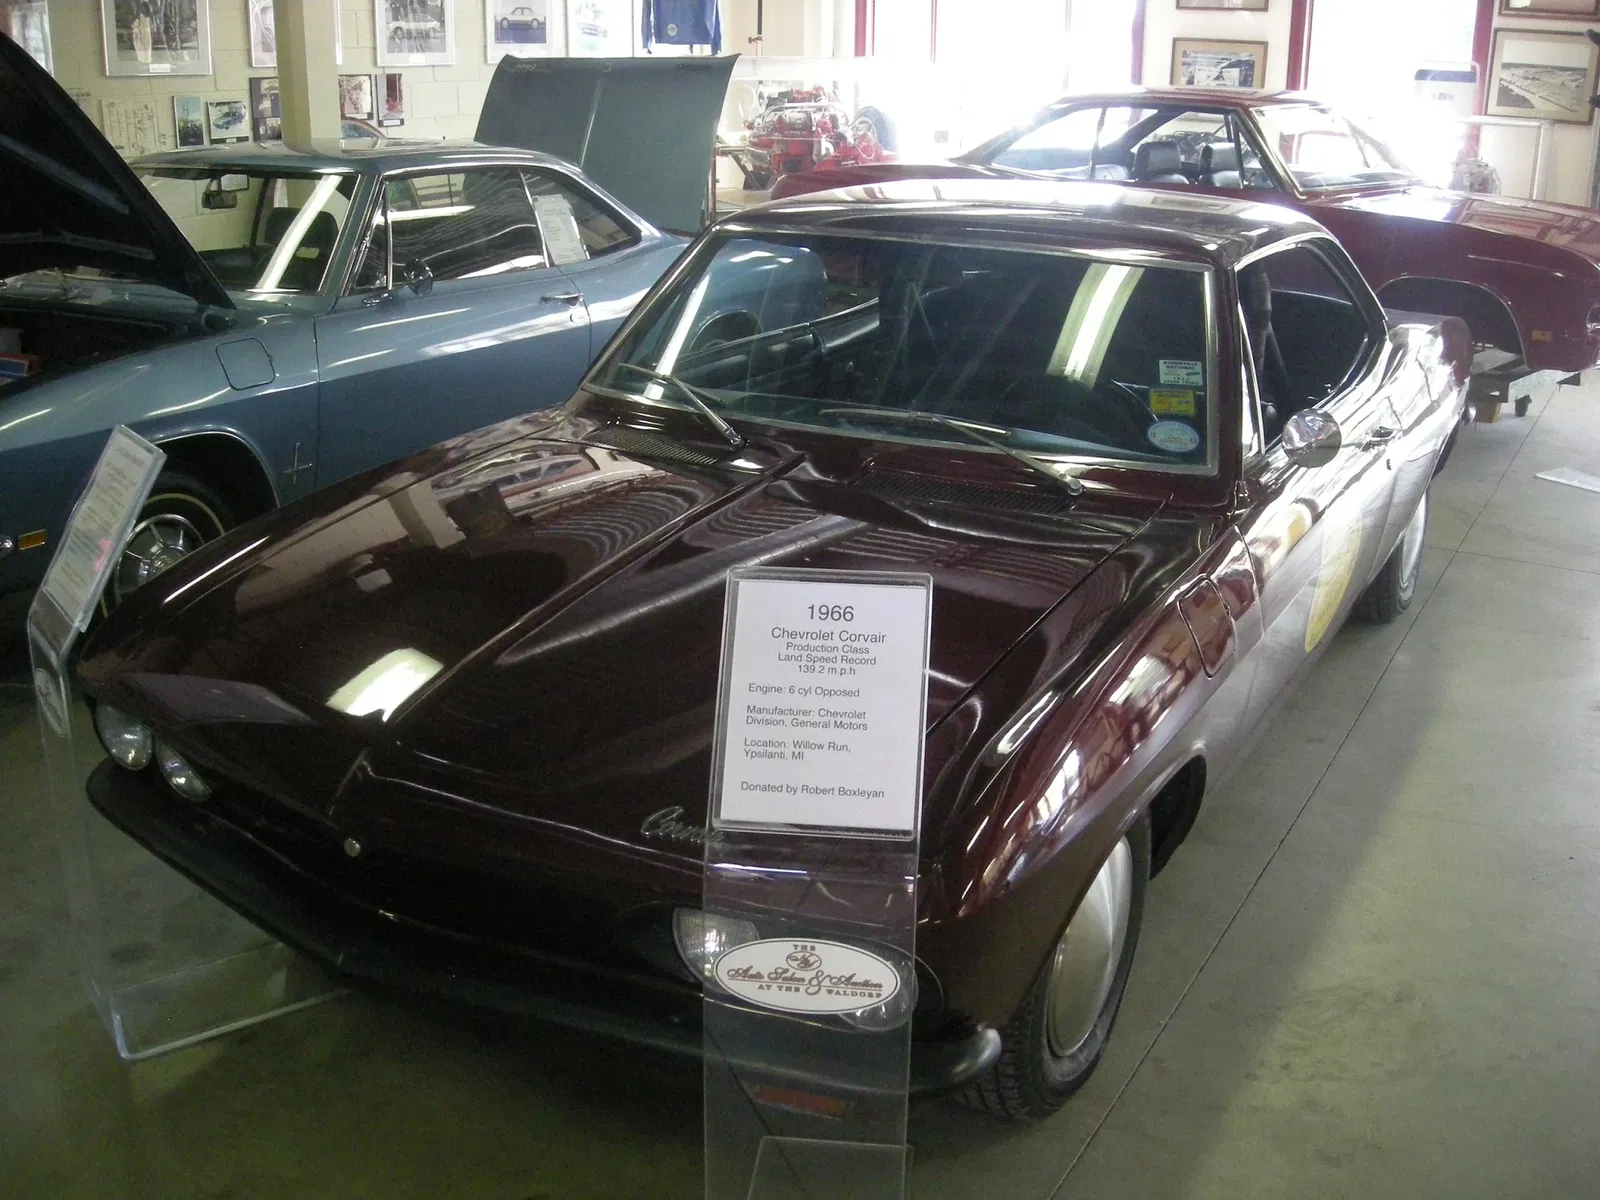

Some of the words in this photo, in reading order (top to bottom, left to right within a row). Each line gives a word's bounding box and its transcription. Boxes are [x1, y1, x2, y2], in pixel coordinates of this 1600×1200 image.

[808, 604, 854, 622] 1966
[771, 627, 834, 641] Chevrolet
[838, 630, 887, 643] Corvair
[786, 642, 838, 653] Production
[841, 644, 869, 654] Class
[778, 652, 803, 662] Land
[806, 653, 837, 665] Speed
[841, 655, 876, 665] Record
[798, 665, 824, 674] 139.2
[748, 683, 786, 695] Engine:
[788, 685, 795, 694] 6
[798, 686, 812, 697] cyl
[815, 686, 860, 698] Opposed
[746, 705, 815, 717] Manufacturer:
[818, 708, 866, 719] Chevrolet
[746, 716, 788, 727] Division,
[791, 717, 831, 728] General
[834, 720, 868, 730] Motors
[744, 737, 789, 748] Location:
[792, 740, 824, 750] Willow
[827, 741, 851, 753] Run,
[744, 749, 788, 760] Ypsilanti,
[792, 751, 804, 760] MI
[741, 781, 783, 793] Donated
[786, 784, 798, 795] by
[801, 785, 835, 796] Robert
[838, 787, 885, 799] Boxleyan
[727, 966, 764, 979] Auto
[767, 967, 806, 984] Salon
[805, 969, 831, 996] &
[829, 972, 884, 989] Auction
[777, 985, 801, 993] THE
[826, 989, 883, 999] WALDORF
